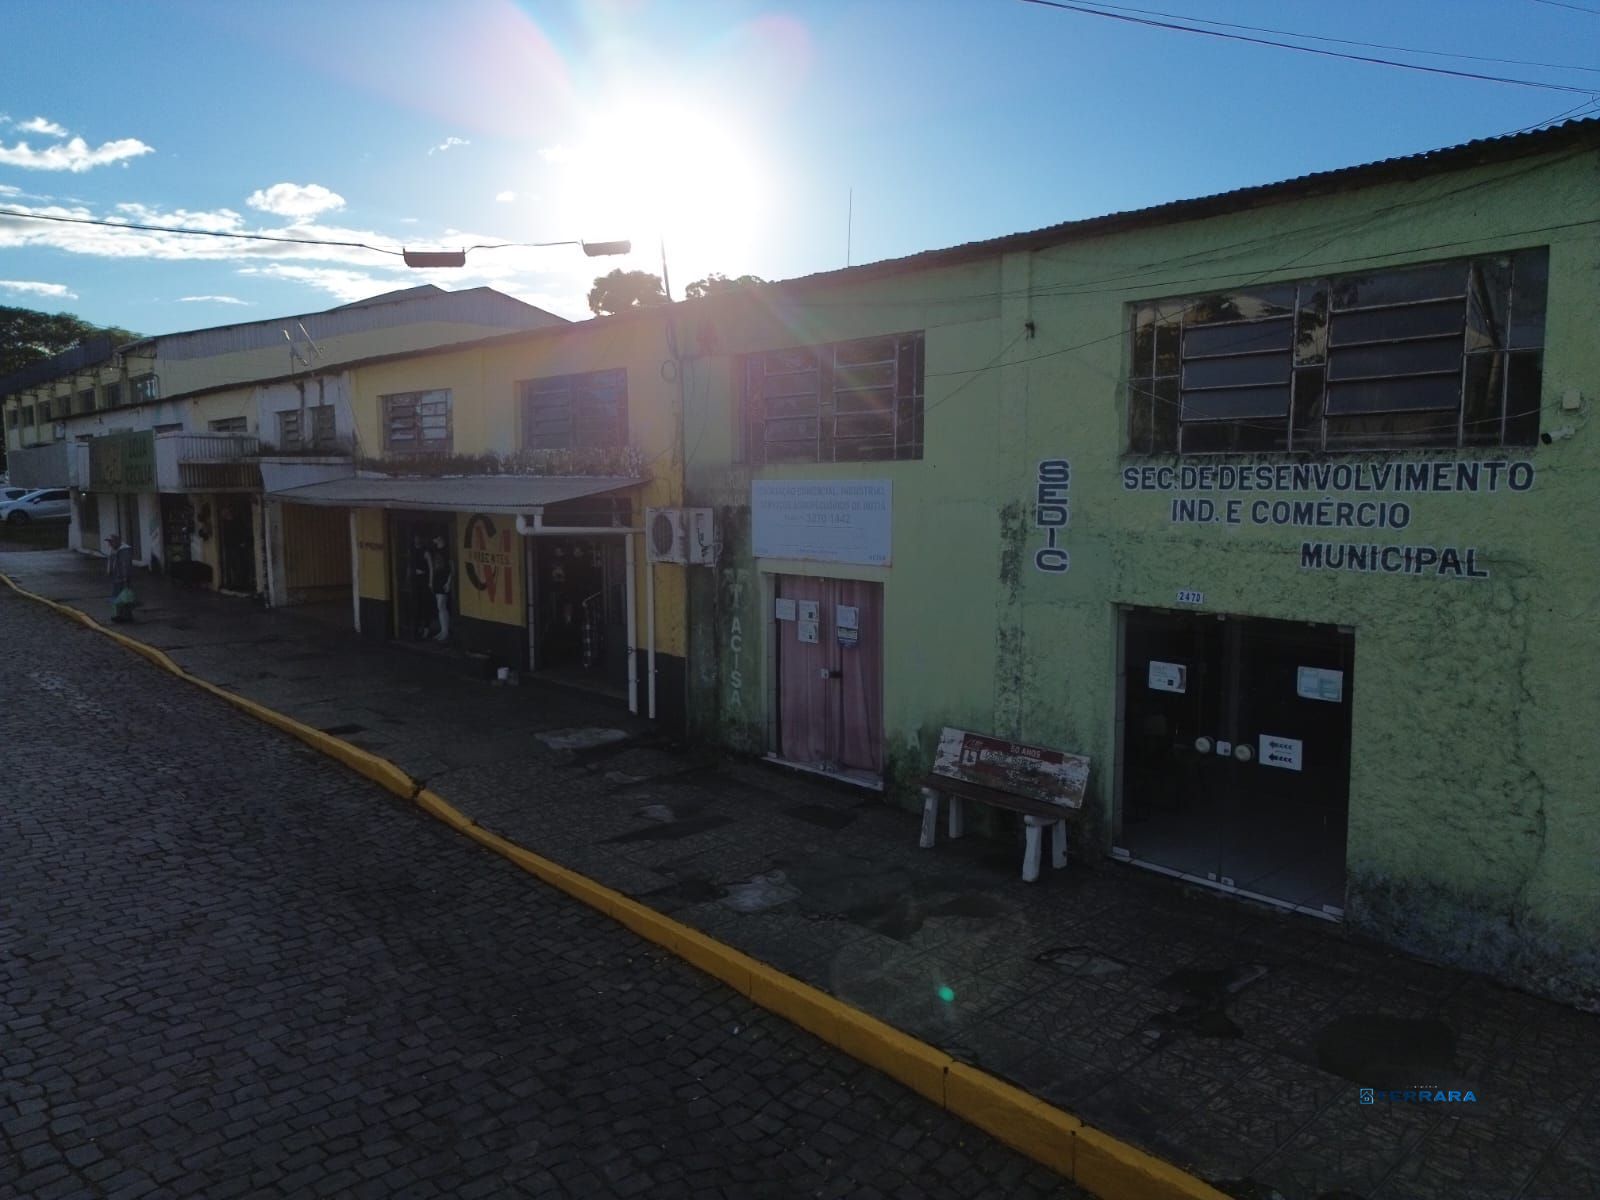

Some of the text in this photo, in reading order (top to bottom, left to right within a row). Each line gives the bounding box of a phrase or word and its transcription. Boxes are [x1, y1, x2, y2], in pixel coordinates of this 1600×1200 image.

[1035, 459, 1071, 574] SEDIC
[1171, 496, 1411, 529] IND. E COMÉRCIO
[1300, 541, 1490, 578] MUNICIPAL
[1178, 591, 1202, 603] 2470
[729, 616, 743, 707] ACISA
